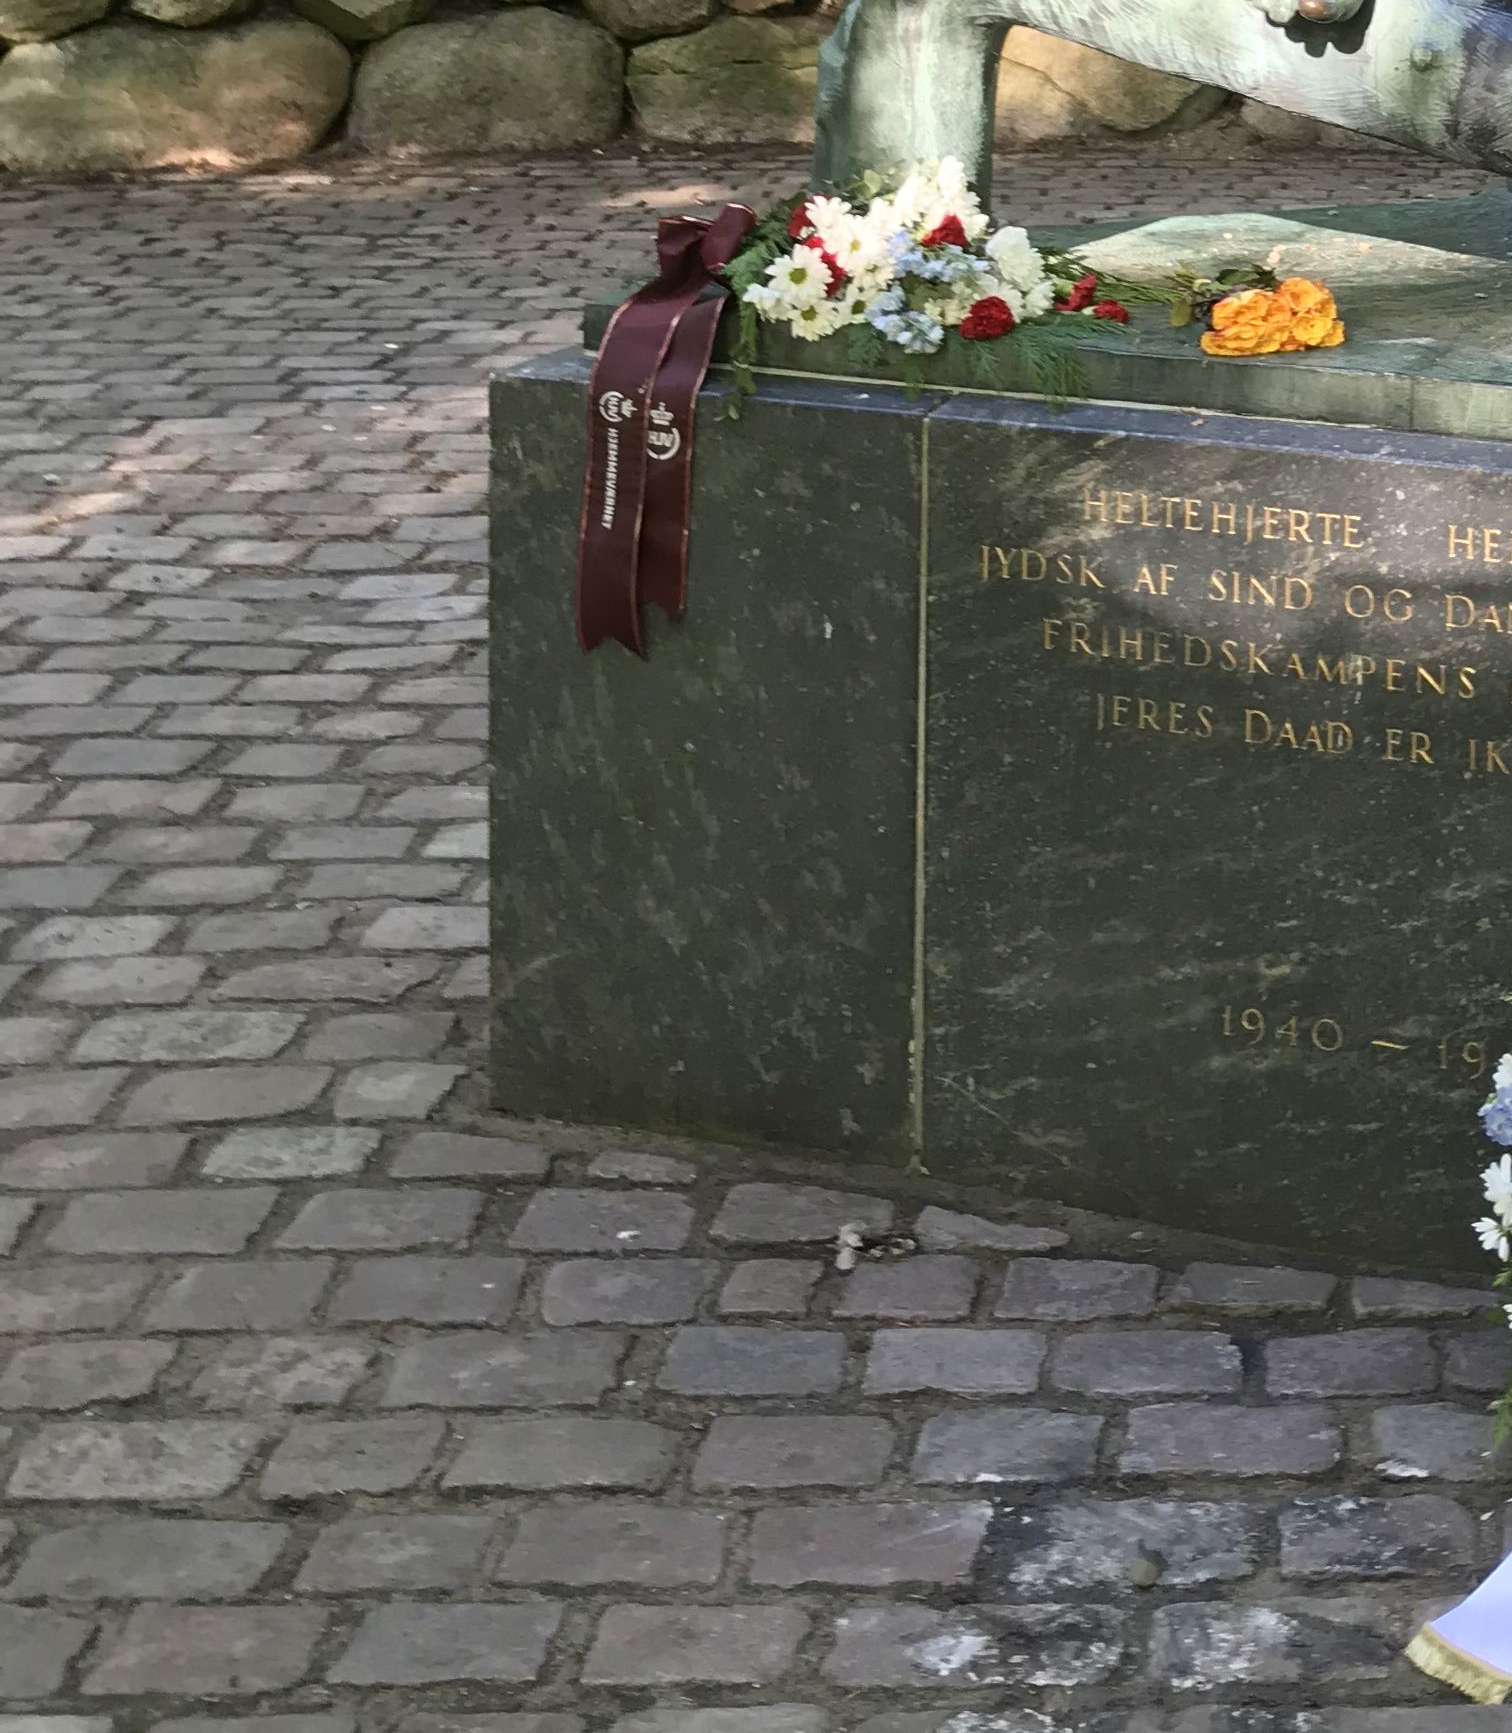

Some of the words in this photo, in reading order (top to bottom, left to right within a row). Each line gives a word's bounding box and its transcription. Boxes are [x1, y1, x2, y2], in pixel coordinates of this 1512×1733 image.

[1083, 486, 1363, 549] HELTEHJERTE
[979, 544, 1106, 588] JYDSK
[1132, 562, 1179, 596] AF
[1208, 569, 1314, 611] SIND
[1344, 584, 1415, 624] OG
[1042, 618, 1476, 699] FRIHEDSKAMPENS
[1096, 692, 1214, 738] JERES
[1243, 709, 1354, 755] DAAD
[1384, 728, 1435, 765] ER
[1222, 1004, 1344, 1052] 1940
